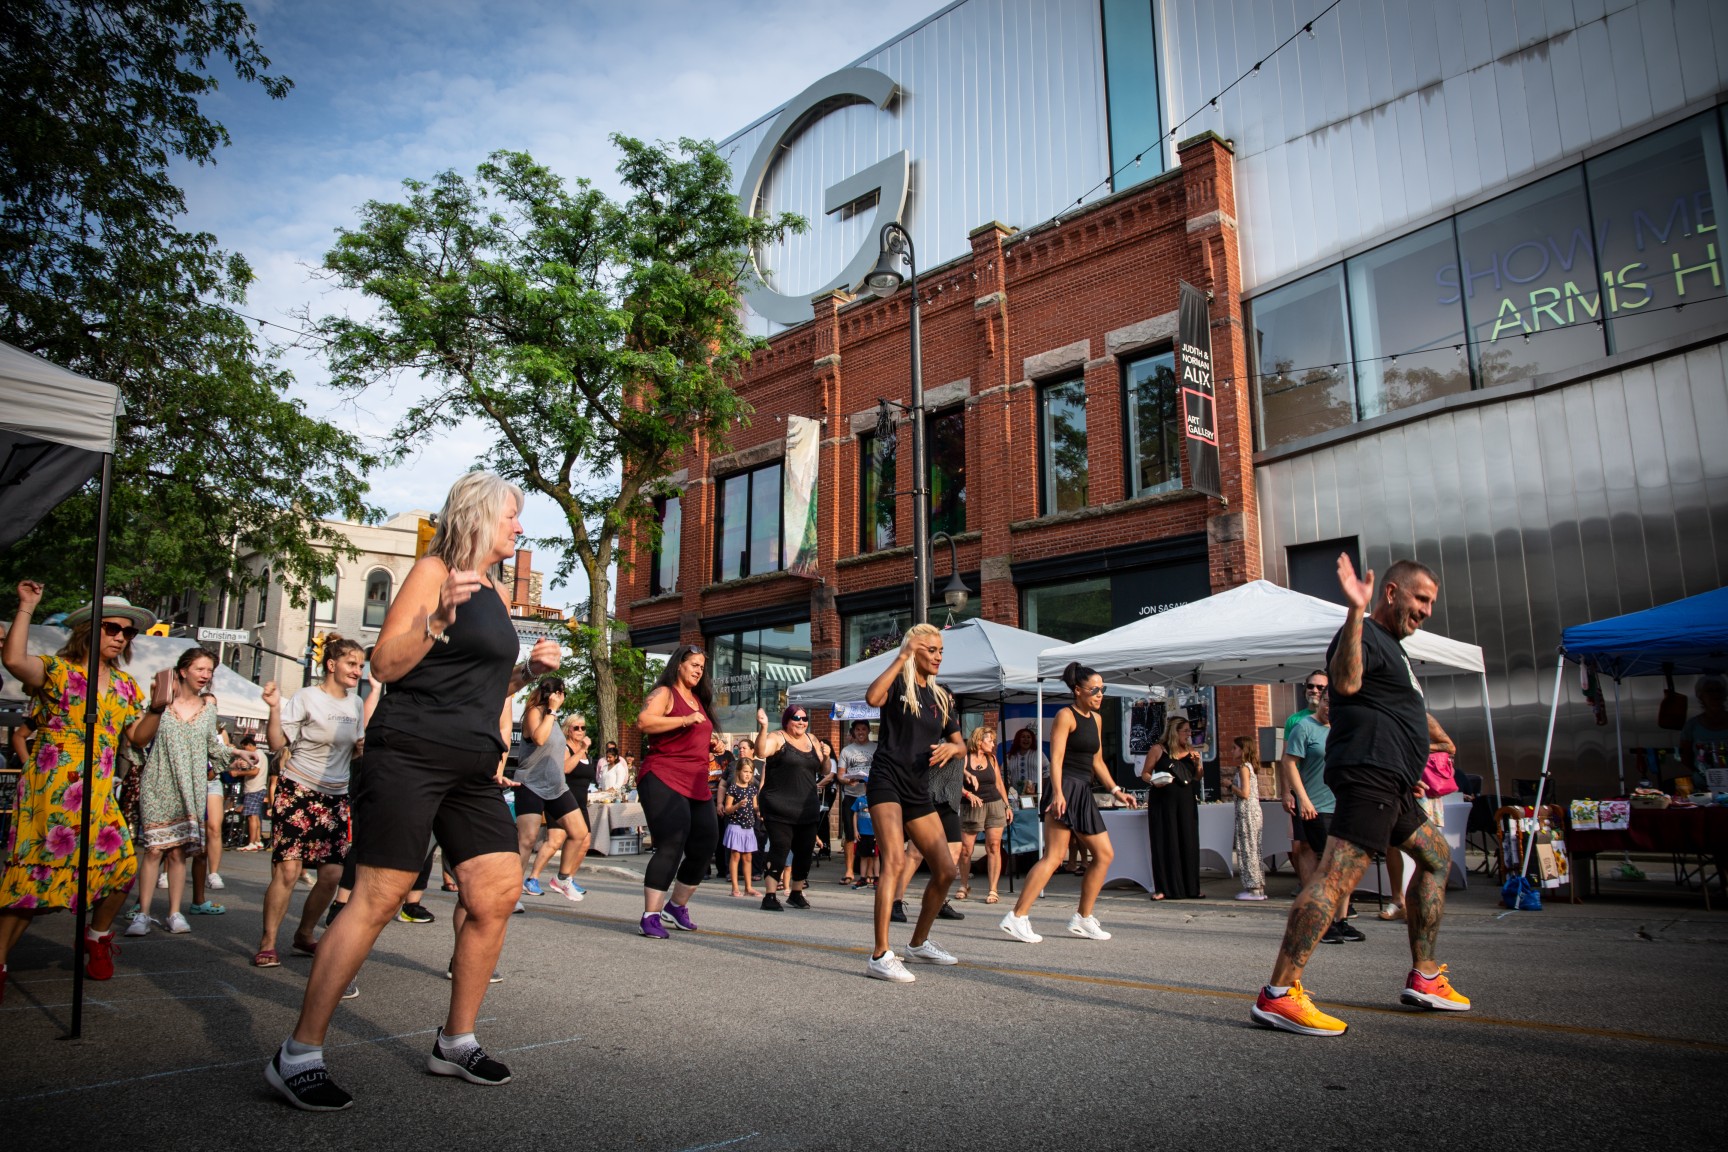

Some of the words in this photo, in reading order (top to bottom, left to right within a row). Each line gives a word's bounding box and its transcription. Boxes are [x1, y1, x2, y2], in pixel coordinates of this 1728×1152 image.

[739, 67, 910, 325] G
[1435, 218, 1610, 304] SHOW
[1632, 190, 1719, 251] ME
[1490, 262, 1655, 343] ARMS
[1182, 343, 1203, 358] JUDITH
[1203, 351, 1209, 360] &
[1182, 353, 1210, 371] NORMAN
[1183, 365, 1211, 389] ALIX
[1187, 414, 1200, 425] ART
[1188, 424, 1214, 440] GALLERY
[1139, 605, 1157, 616] JON
[201, 629, 237, 641] Christina
[236, 717, 260, 729] LATIN
